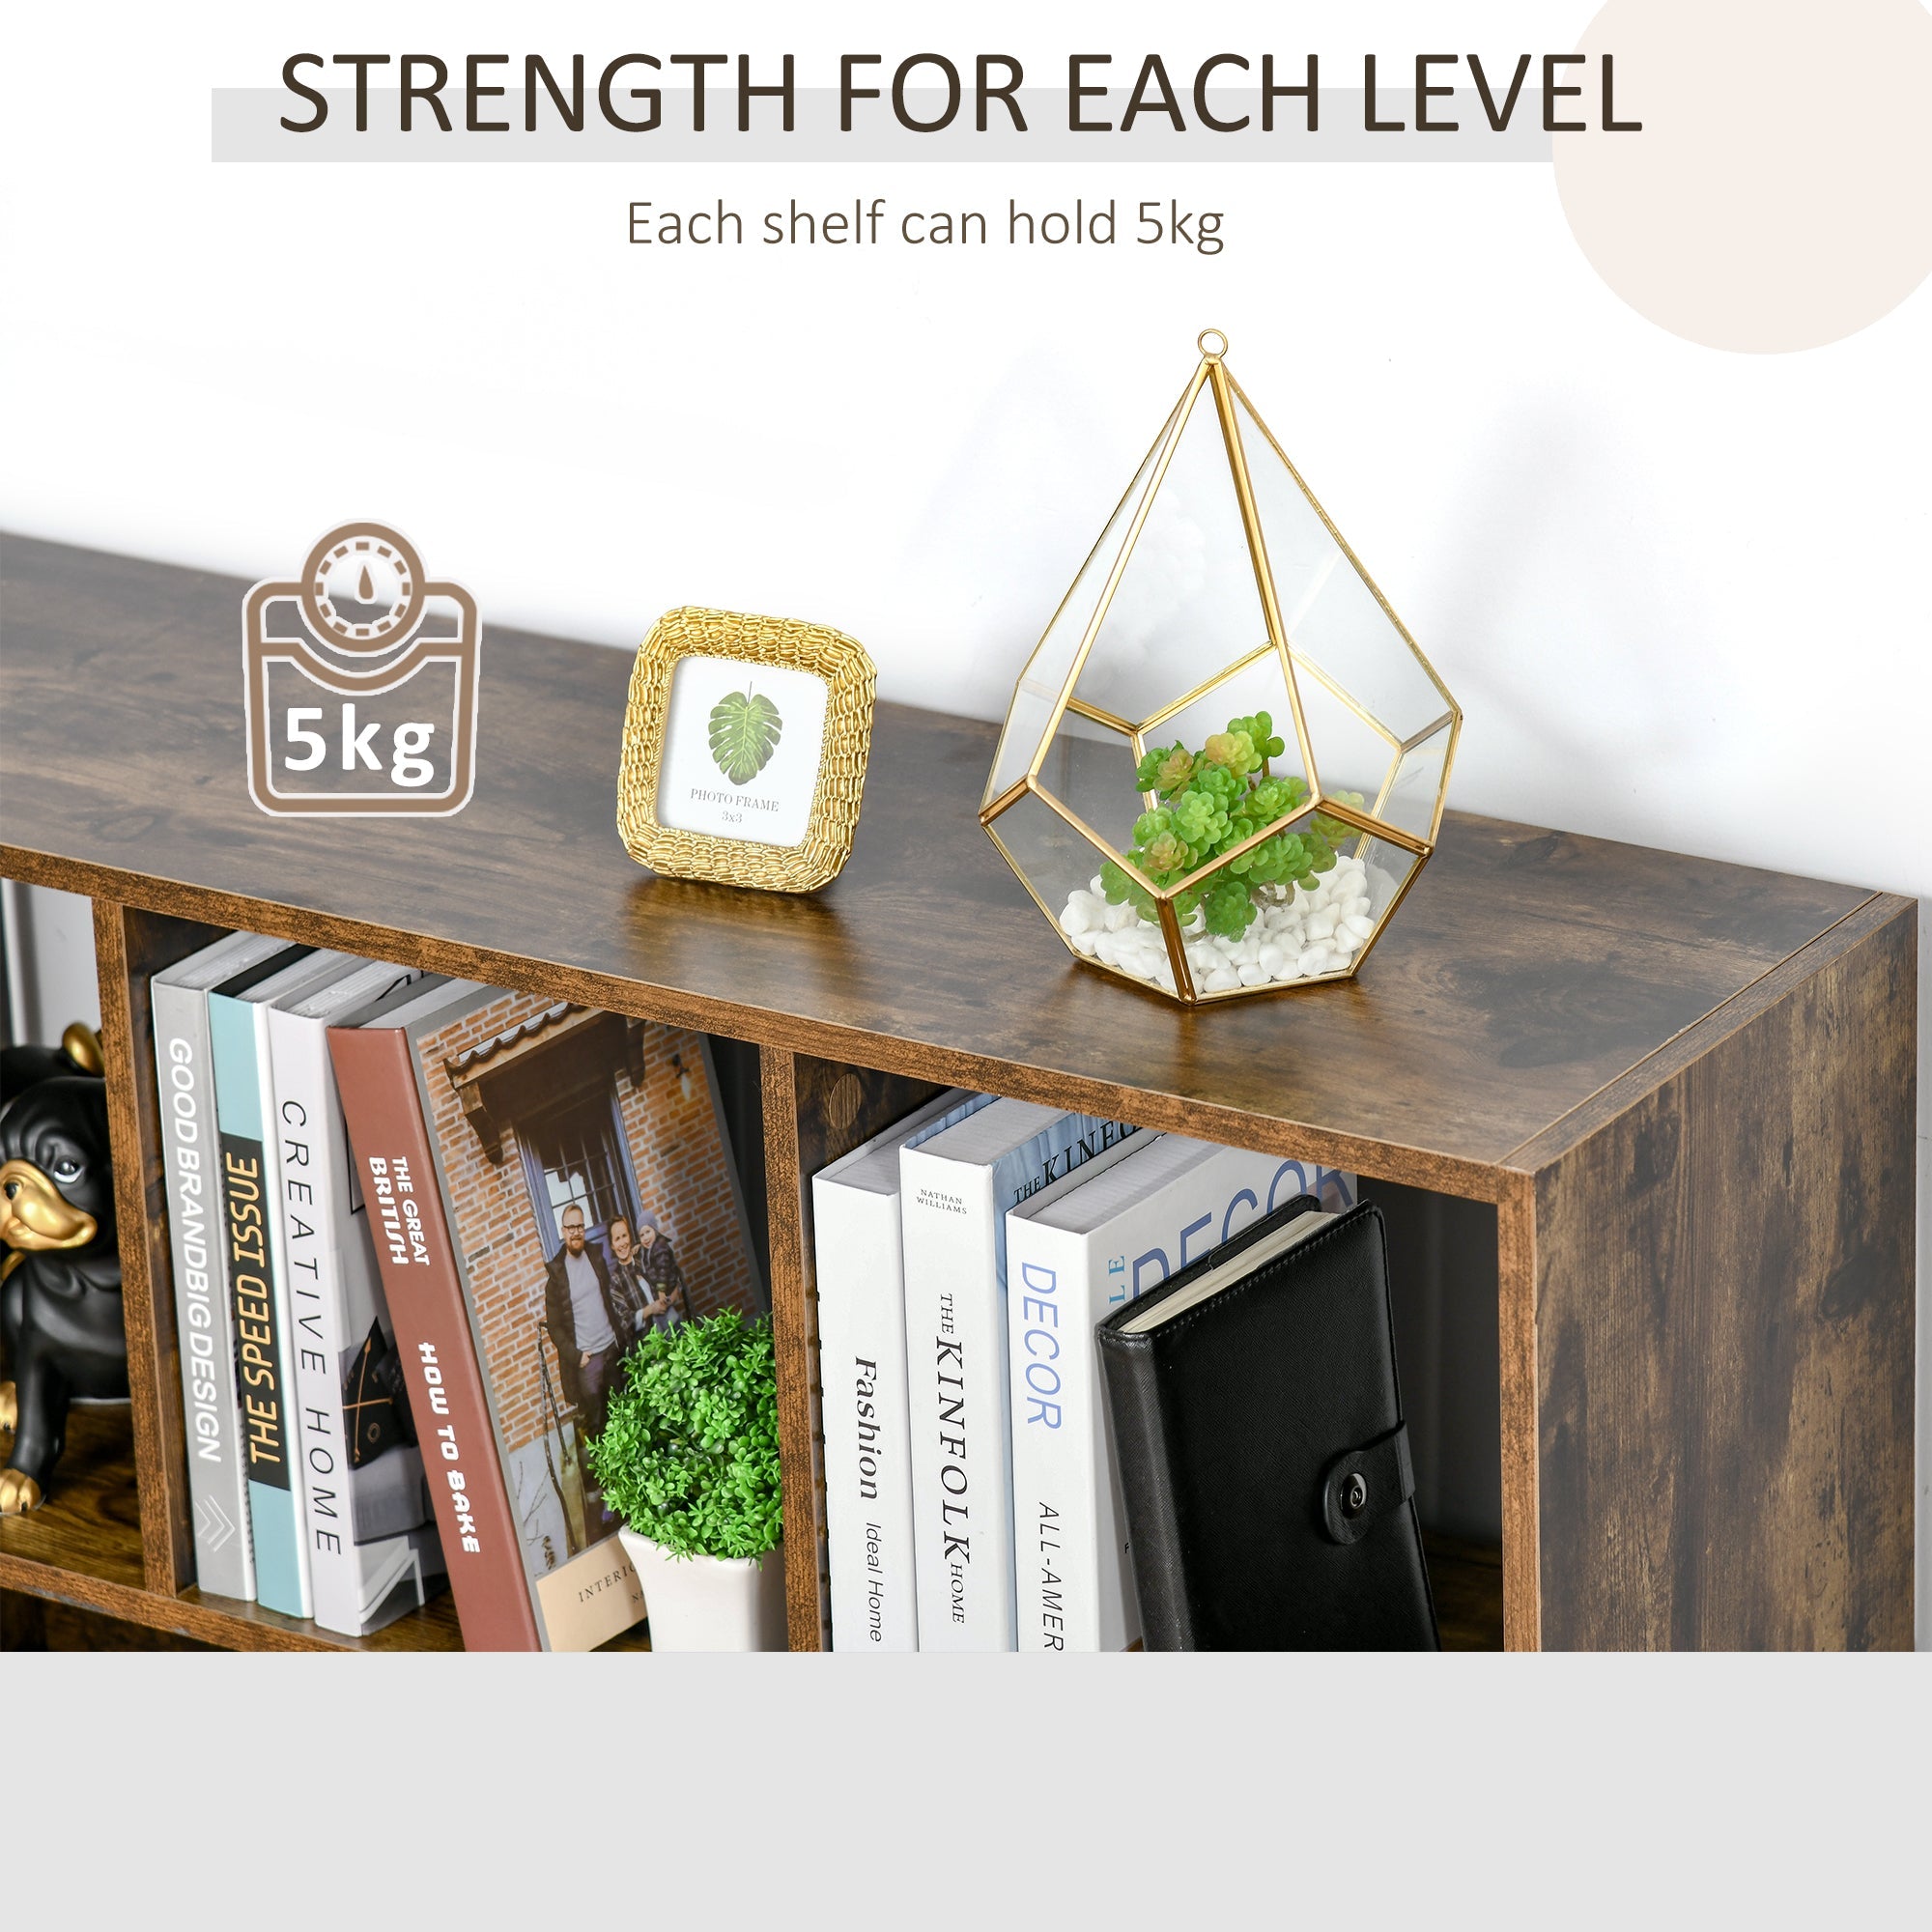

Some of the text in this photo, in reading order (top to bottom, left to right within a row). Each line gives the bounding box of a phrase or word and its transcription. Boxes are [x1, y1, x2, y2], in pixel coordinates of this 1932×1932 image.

[690, 787, 780, 812] PHOTO FRAME
[721, 810, 743, 824] 3x3
[368, 1156, 410, 1264] BRITISH
[391, 1155, 431, 1266] THE GREAT
[916, 1195, 968, 1215] WILLIAMS
[920, 1188, 963, 1206] NATHAN
[1013, 1175, 1042, 1206] THE
[225, 1151, 281, 1464] THE SPEED ISSUE
[282, 1100, 342, 1555] CREATIVE HOME
[1021, 1262, 1063, 1430] DECOR
[417, 1342, 481, 1553] HOW TO BAKE
[854, 1355, 885, 1643] Fashion Ideal Home
[935, 1293, 971, 1624] THE KINFOLK HOME
[1038, 1501, 1065, 1652] ALL-AMER
